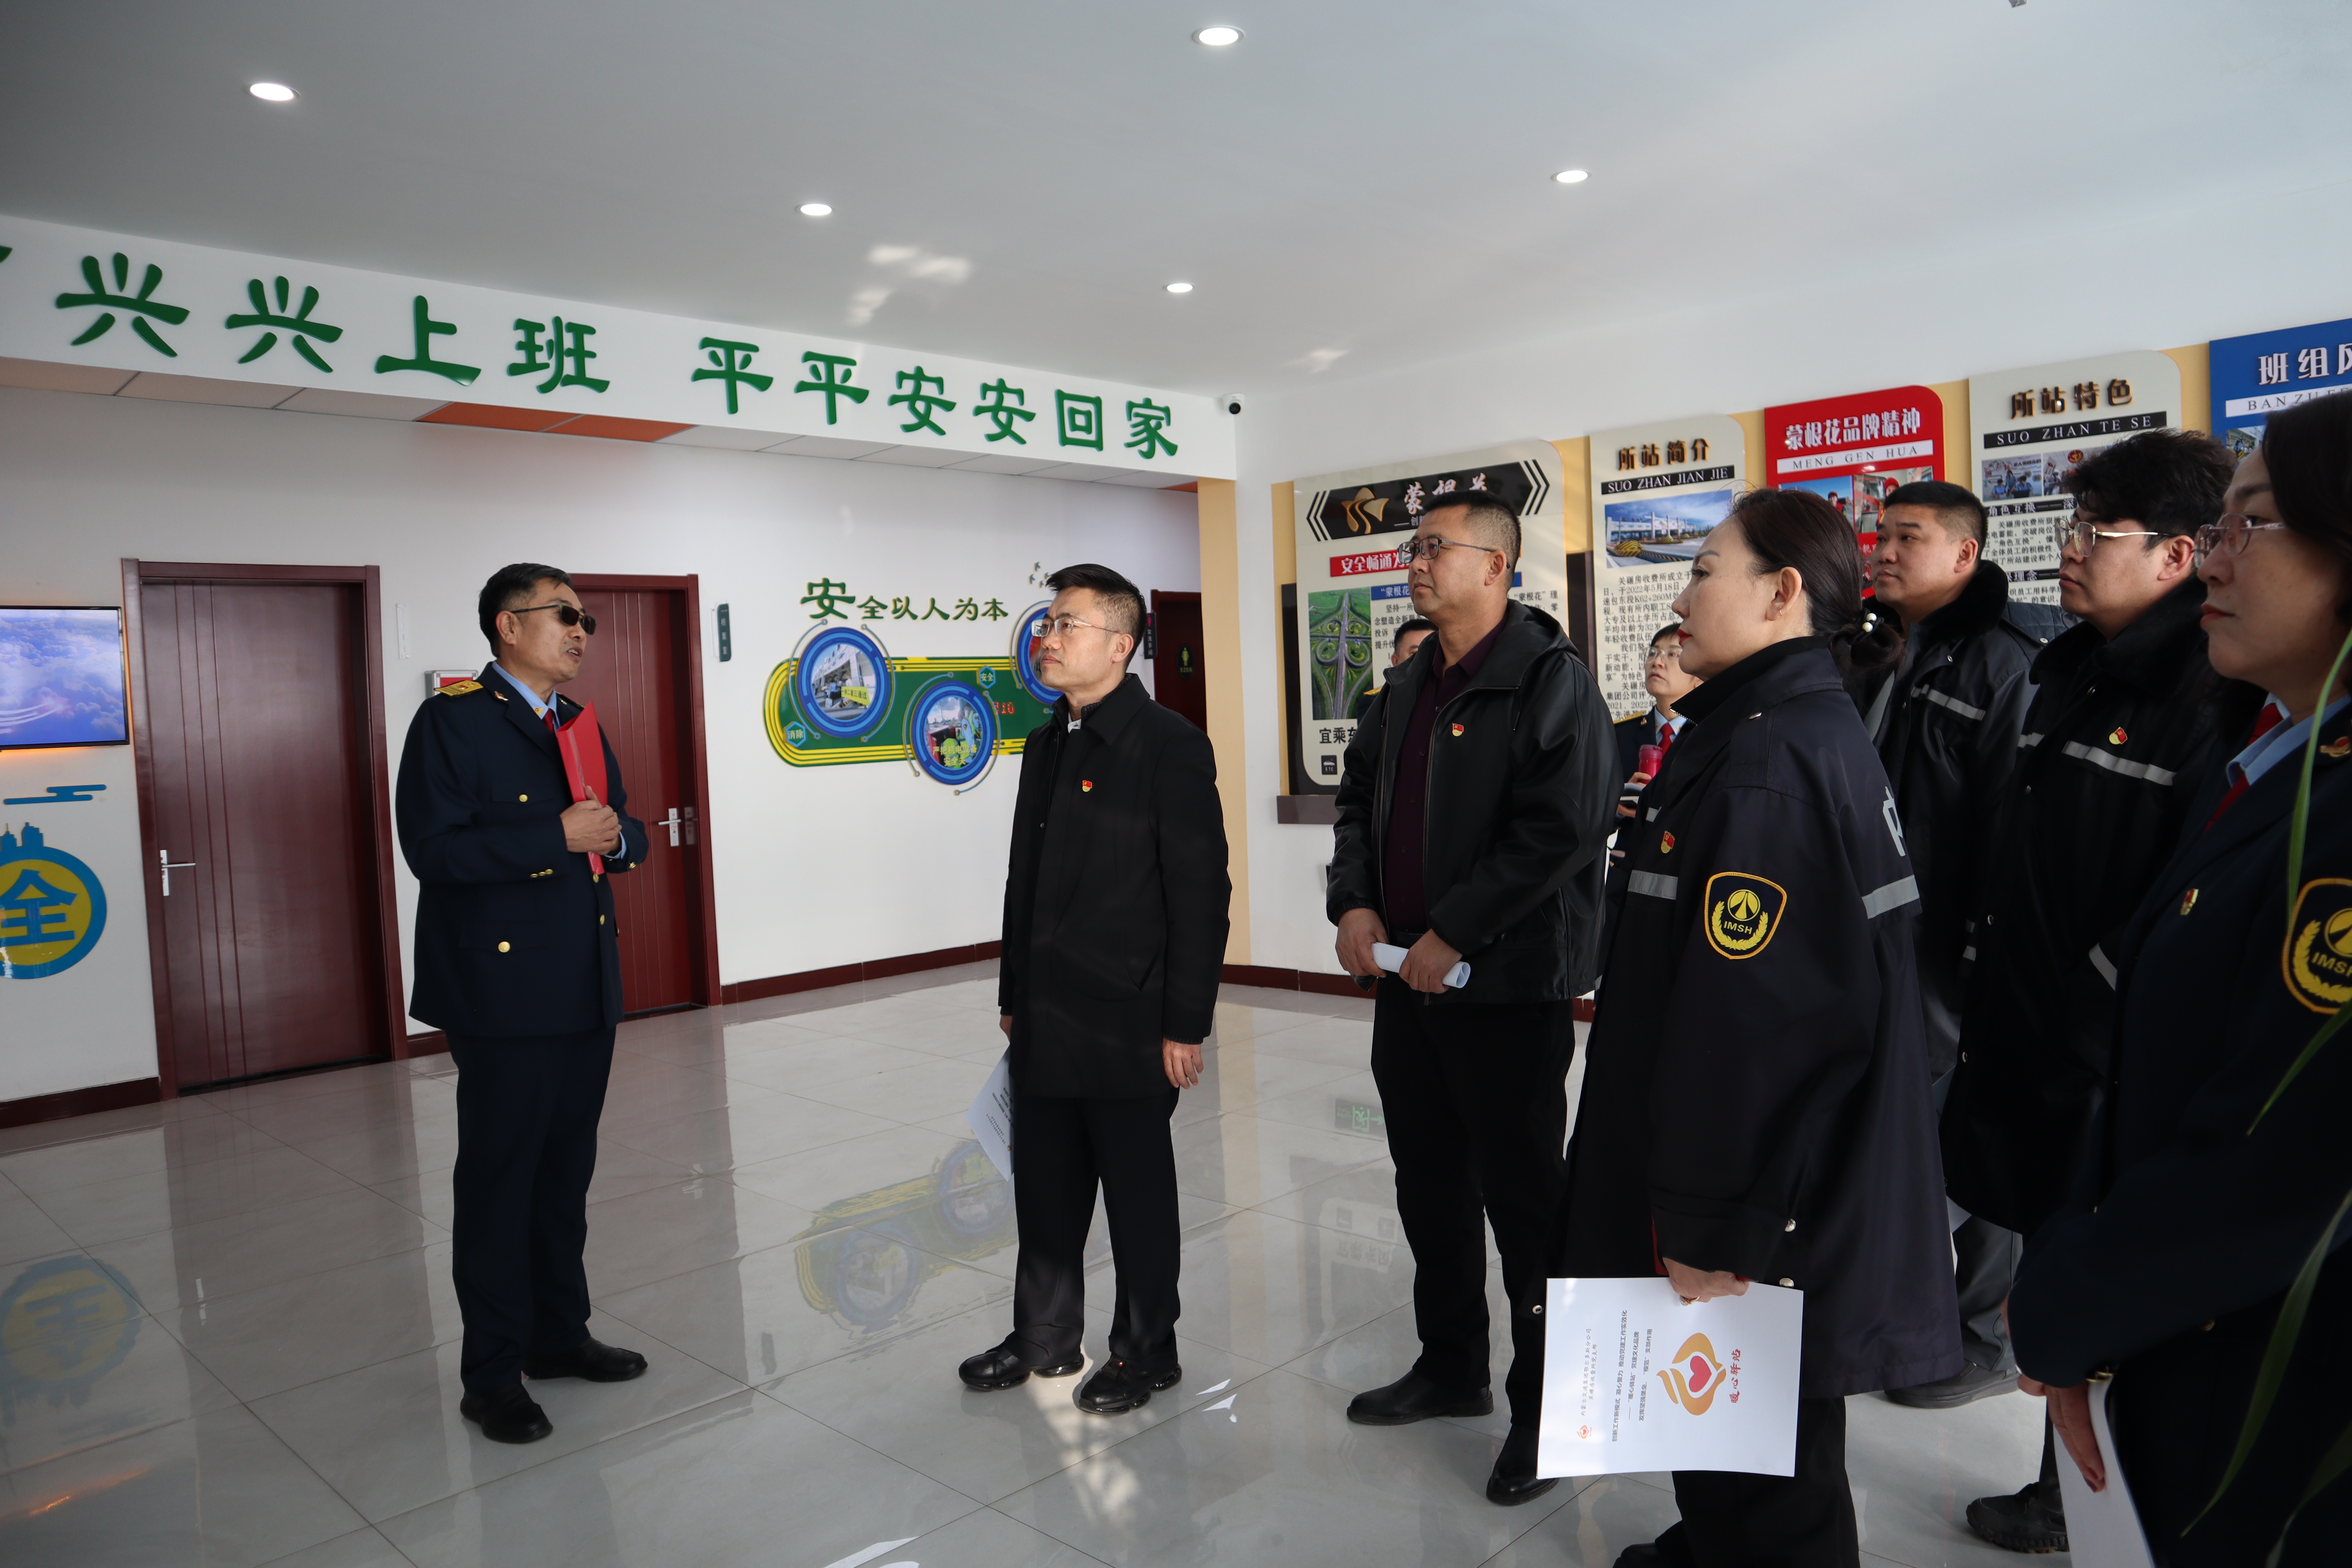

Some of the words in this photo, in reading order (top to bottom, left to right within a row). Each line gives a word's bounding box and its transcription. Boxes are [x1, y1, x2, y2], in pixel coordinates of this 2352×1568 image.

[0, 246, 610, 394] 兴兴上班
[691, 337, 1178, 459] 平平安安回家
[2011, 379, 2133, 419] 所站特色
[2248, 396, 2287, 410] BAN
[1785, 407, 1920, 451] 蒙根花品牌精神
[1997, 431, 2030, 445] SUO
[2042, 423, 2090, 439] ZHAN
[2100, 419, 2121, 432] TE
[2131, 415, 2151, 429] SE
[1619, 438, 1709, 471] 所站简介
[1793, 456, 1834, 470] MENG
[1845, 451, 1875, 463] GEN
[1886, 445, 1918, 458] HUA
[1608, 480, 1632, 493] SUO
[1637, 475, 1671, 489] ZHAN
[1677, 470, 1704, 484] JIAN
[1710, 467, 1728, 480] JIE
[1341, 552, 1410, 574] 安全畅通为
[800, 577, 1009, 620] 安全以人为本
[1603, 603, 1672, 615] 程。现有所内职工8
[980, 672, 994, 682] 安全
[788, 729, 804, 739] 消除
[932, 744, 977, 755] 严把机电设备
[0, 868, 78, 947] 全
[1723, 921, 1753, 935] IMSH
[1580, 1328, 1592, 1416] 内蒙古交通集团鄂尔多斯分公司
[1588, 1343, 1598, 1401] 关碾房收费所党支部
[1612, 1398, 1621, 1442] 创新工作新模式
[1618, 1310, 1628, 1367] 推动党建工作实效化
[1729, 1348, 1741, 1404] 暖心驿站
